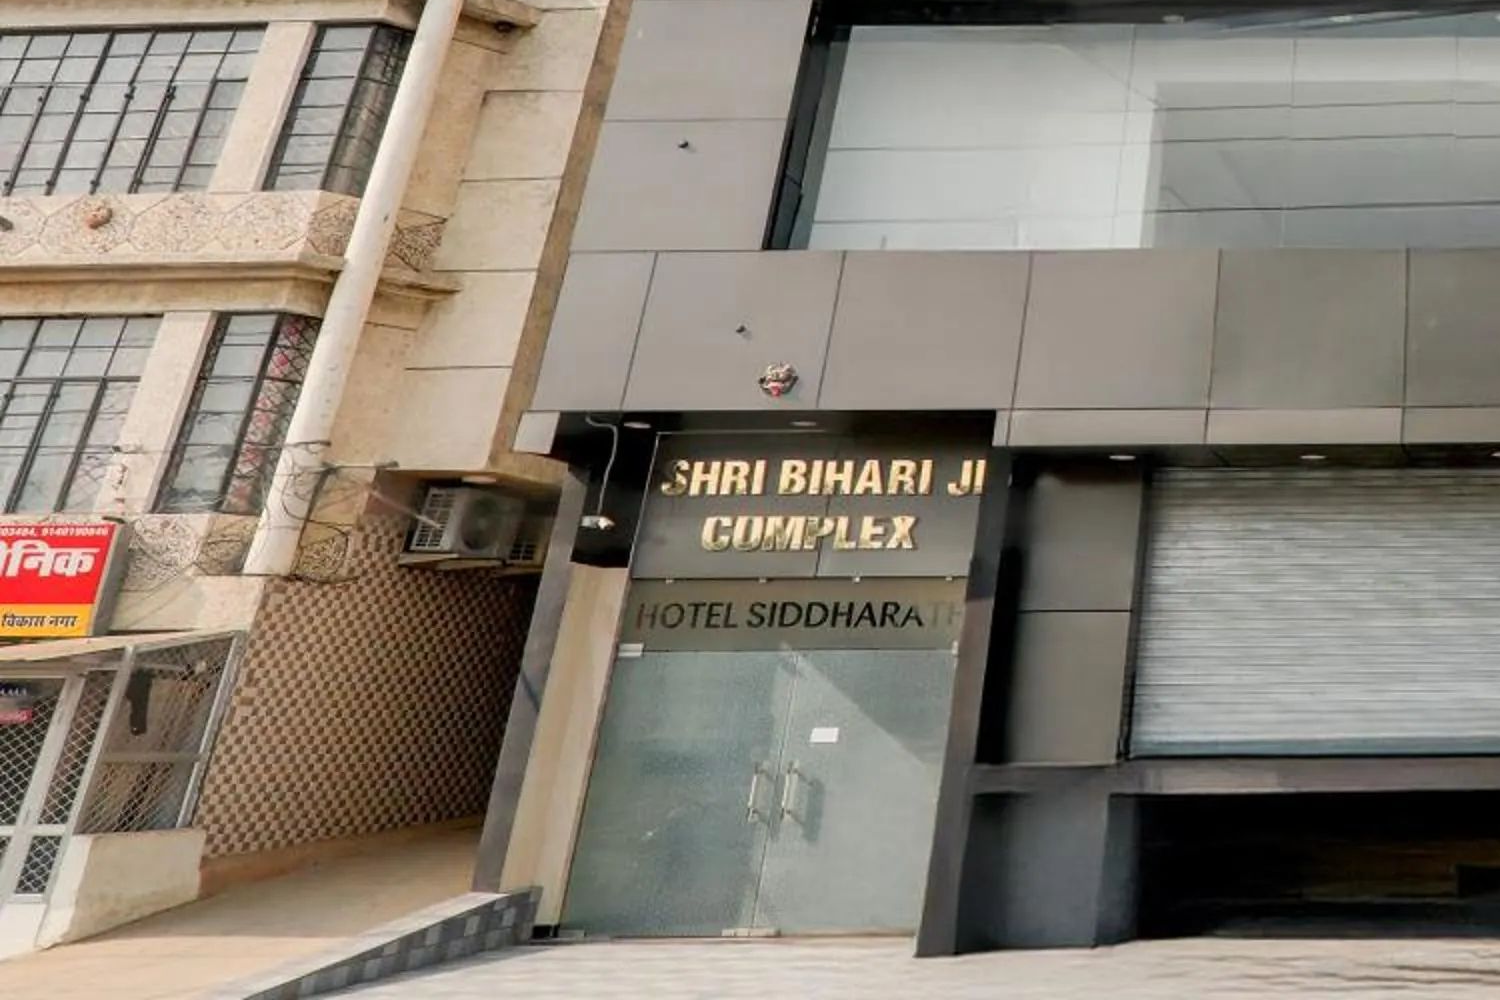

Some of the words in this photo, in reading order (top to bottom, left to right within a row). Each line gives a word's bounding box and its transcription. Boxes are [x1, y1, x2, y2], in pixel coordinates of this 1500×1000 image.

[660, 459, 767, 497] SHRI
[777, 459, 934, 497] BIHARI
[946, 459, 988, 497] JI
[635, 602, 739, 629] HOTEL
